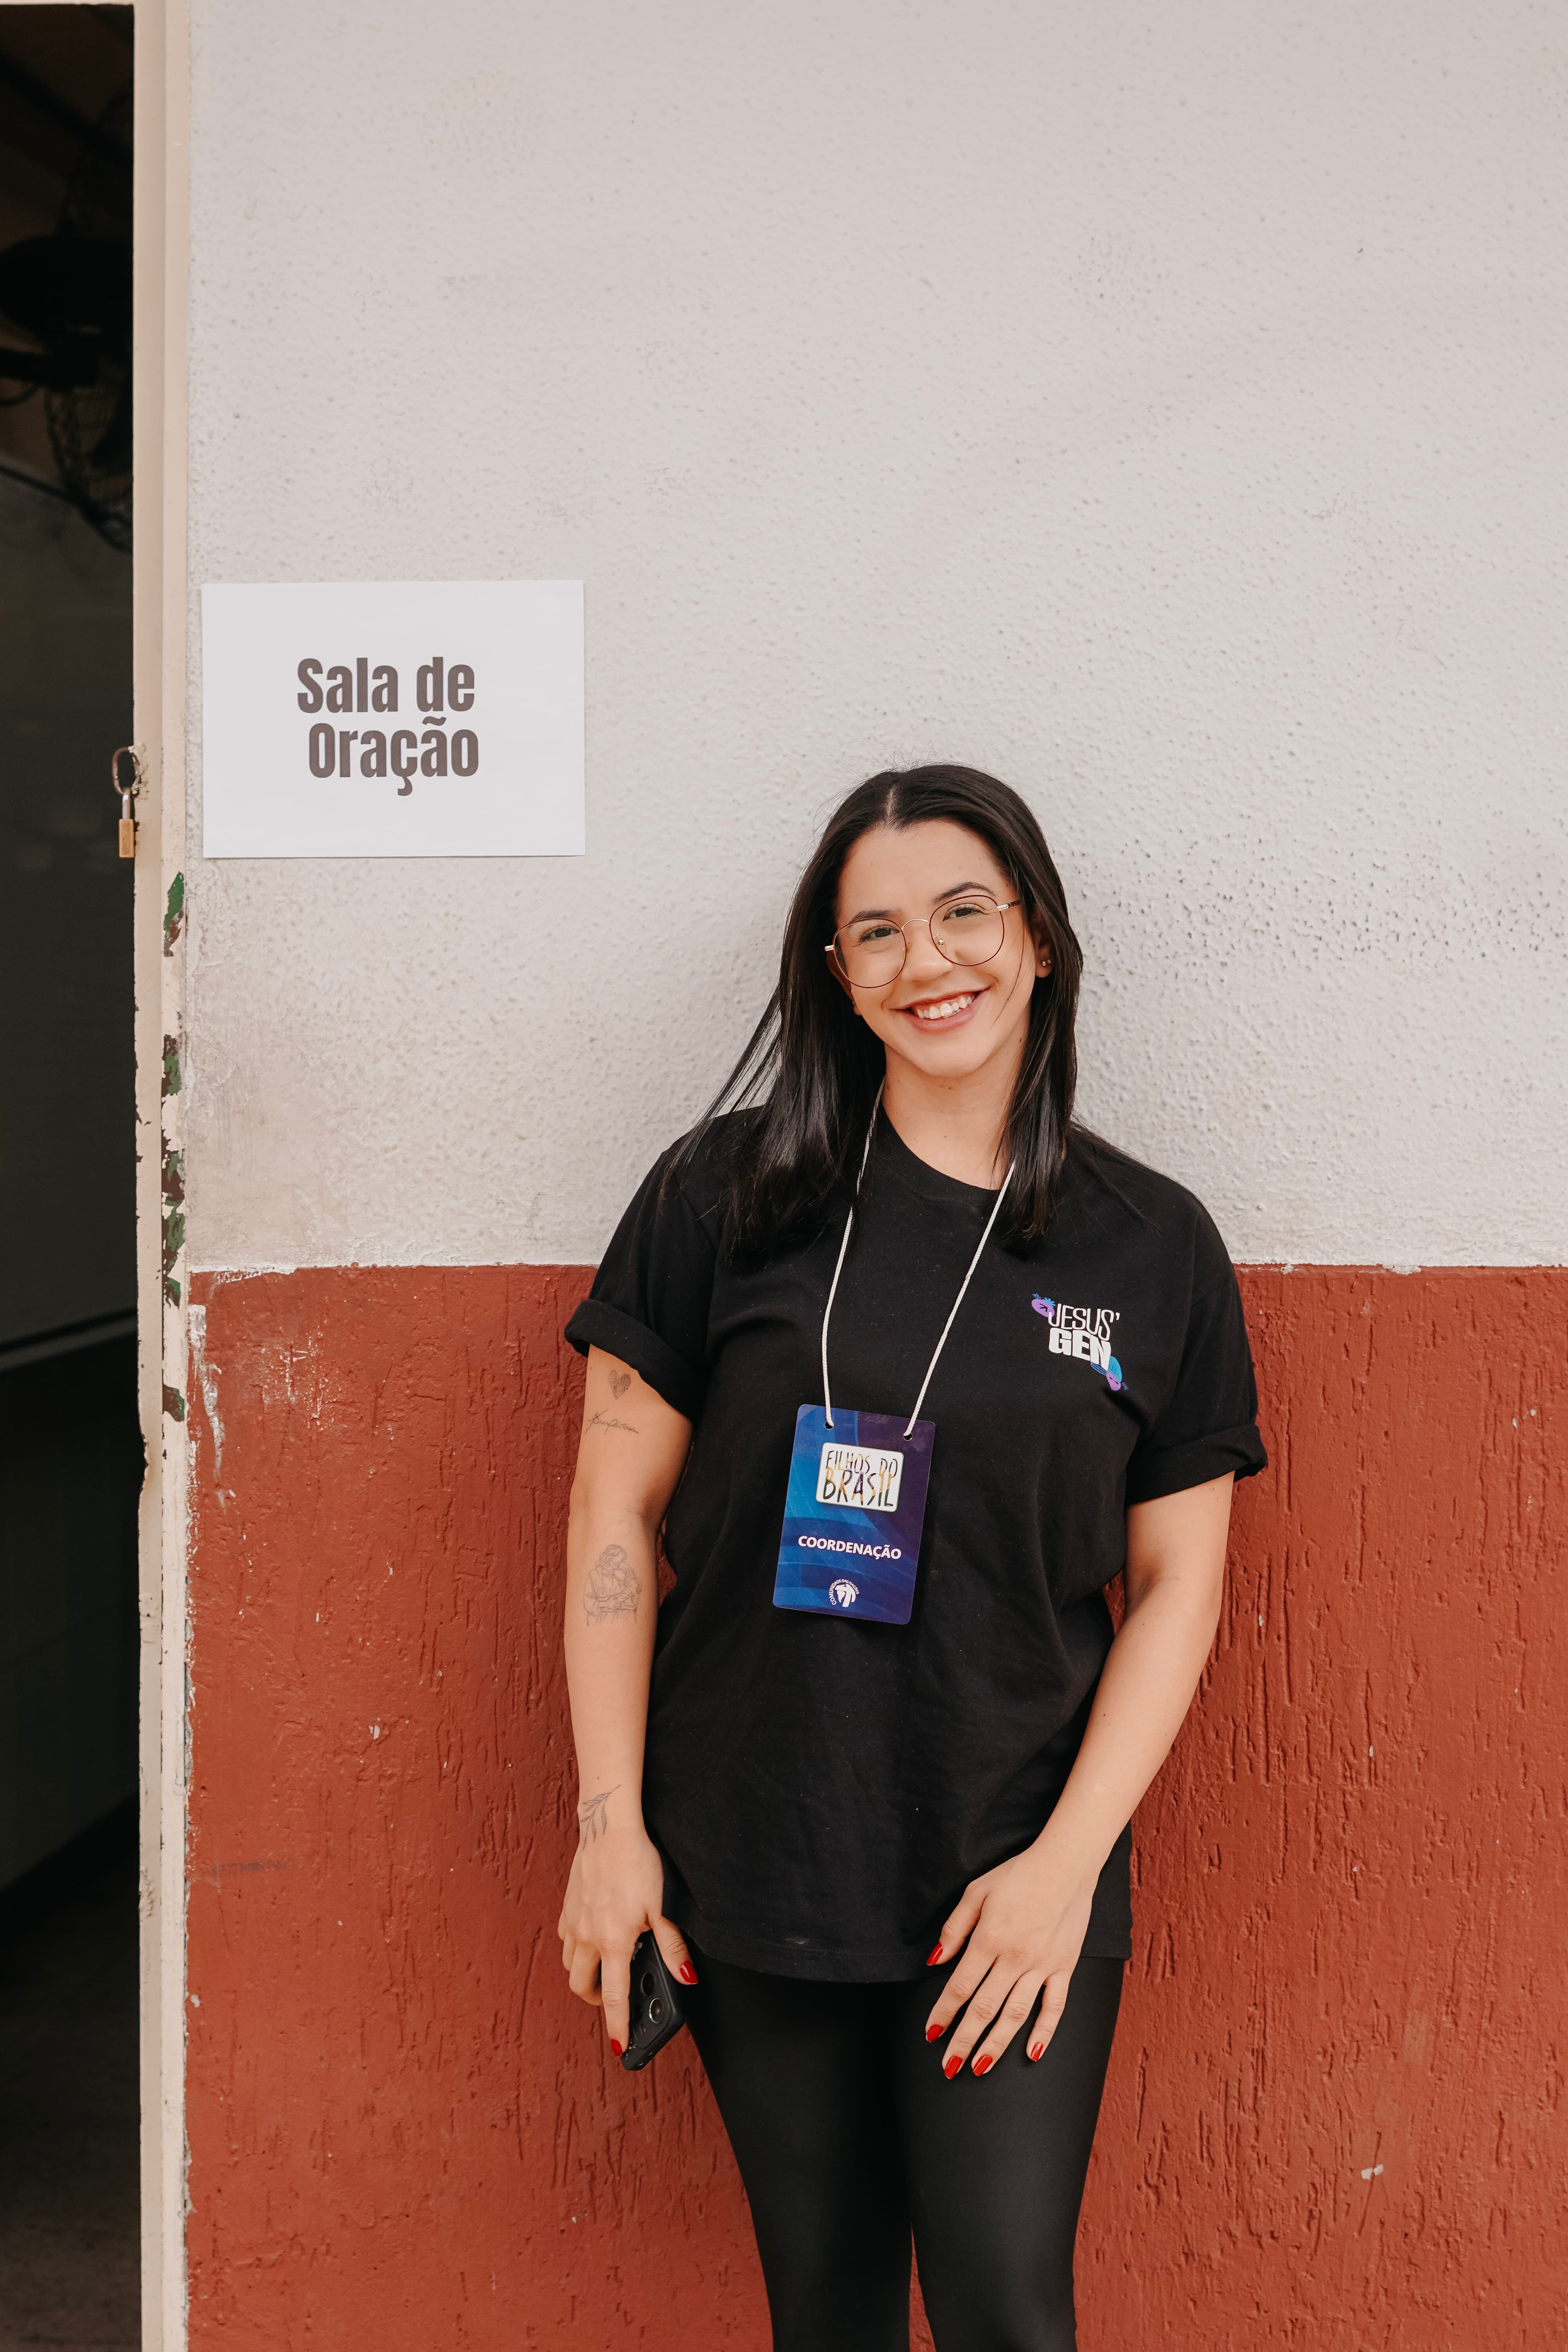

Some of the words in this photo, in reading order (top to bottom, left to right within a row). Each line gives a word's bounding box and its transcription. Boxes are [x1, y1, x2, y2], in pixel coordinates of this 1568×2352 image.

[297, 657, 399, 713] Sala
[416, 656, 475, 712] de
[309, 716, 479, 796] Oração
[1049, 1327, 1111, 1371] GEN
[825, 1450, 870, 1474] FILHOS
[879, 1458, 898, 1478] DO
[823, 1466, 894, 1507] BRASIL
[798, 1535, 902, 1560] COORDENAÇÃO
[829, 1579, 842, 1605] COMUNIDADE
